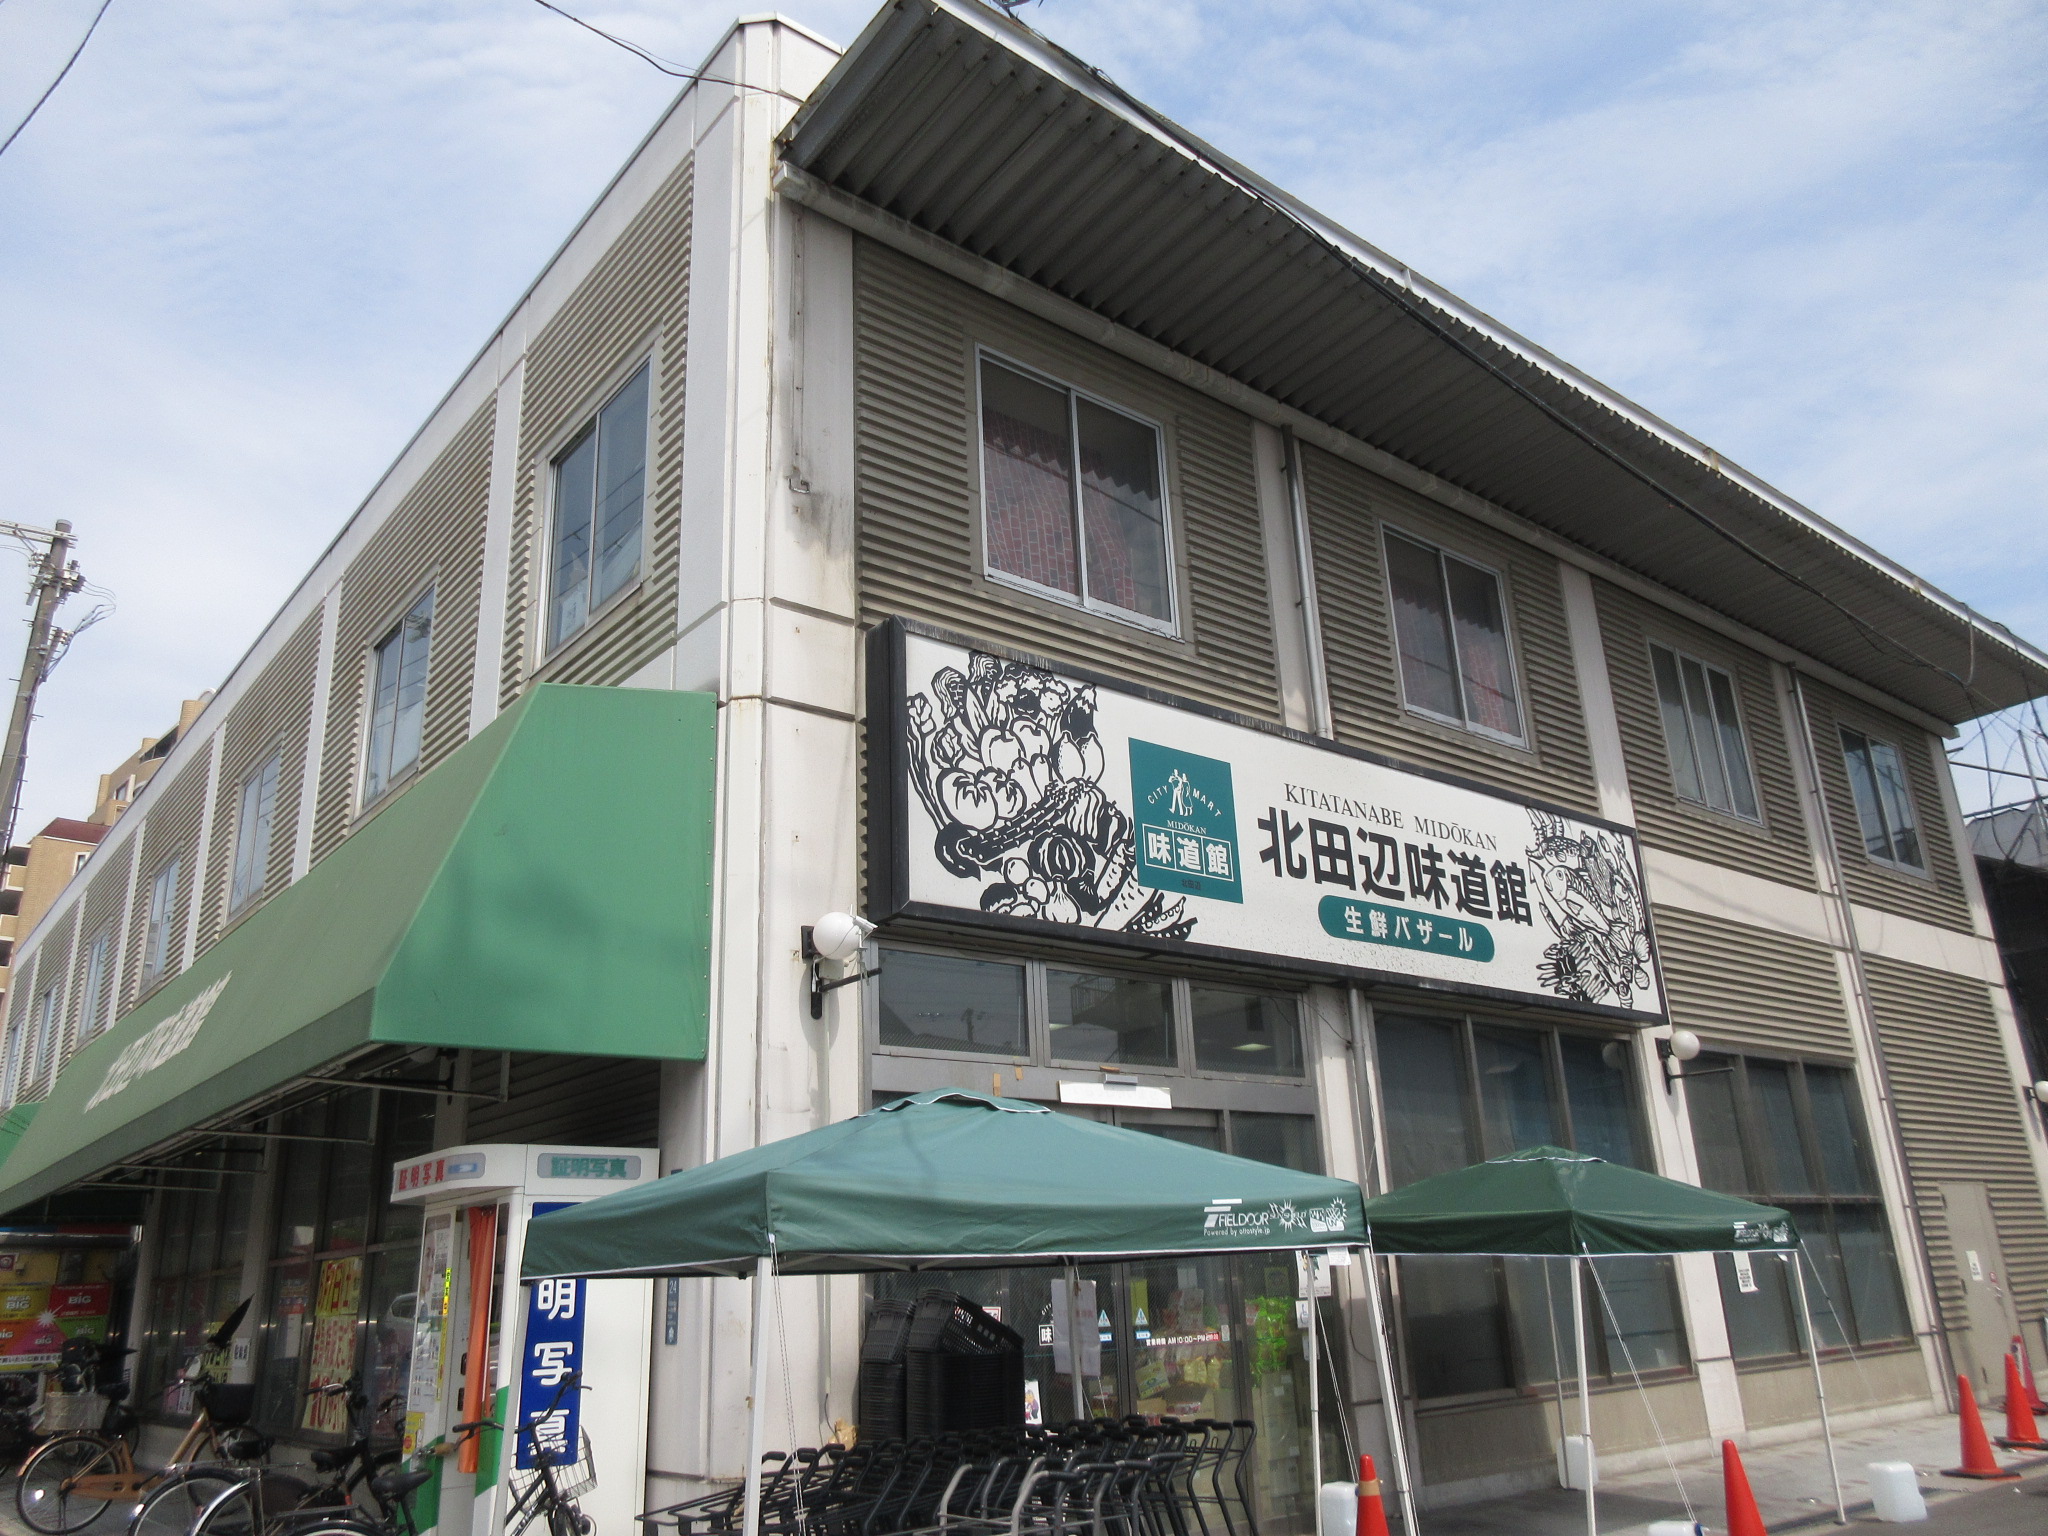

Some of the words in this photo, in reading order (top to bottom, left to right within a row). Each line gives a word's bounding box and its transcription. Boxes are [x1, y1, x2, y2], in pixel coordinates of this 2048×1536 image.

[1147, 785, 1168, 805] CITY
[1192, 788, 1222, 818] MART
[1284, 783, 1404, 830] KITATANABE
[1413, 815, 1498, 852] MIDŌKAN
[1166, 819, 1207, 835] MIDŌKAN
[1147, 831, 1230, 876] 味道館
[1257, 806, 1534, 927] 北田辺味道館
[1344, 905, 1474, 952] 生鮮バザール
[398, 1159, 446, 1190] 証明写真
[551, 1156, 628, 1178] 証明写真
[1203, 1228, 1229, 1237] Powered
[1230, 1226, 1238, 1237] by
